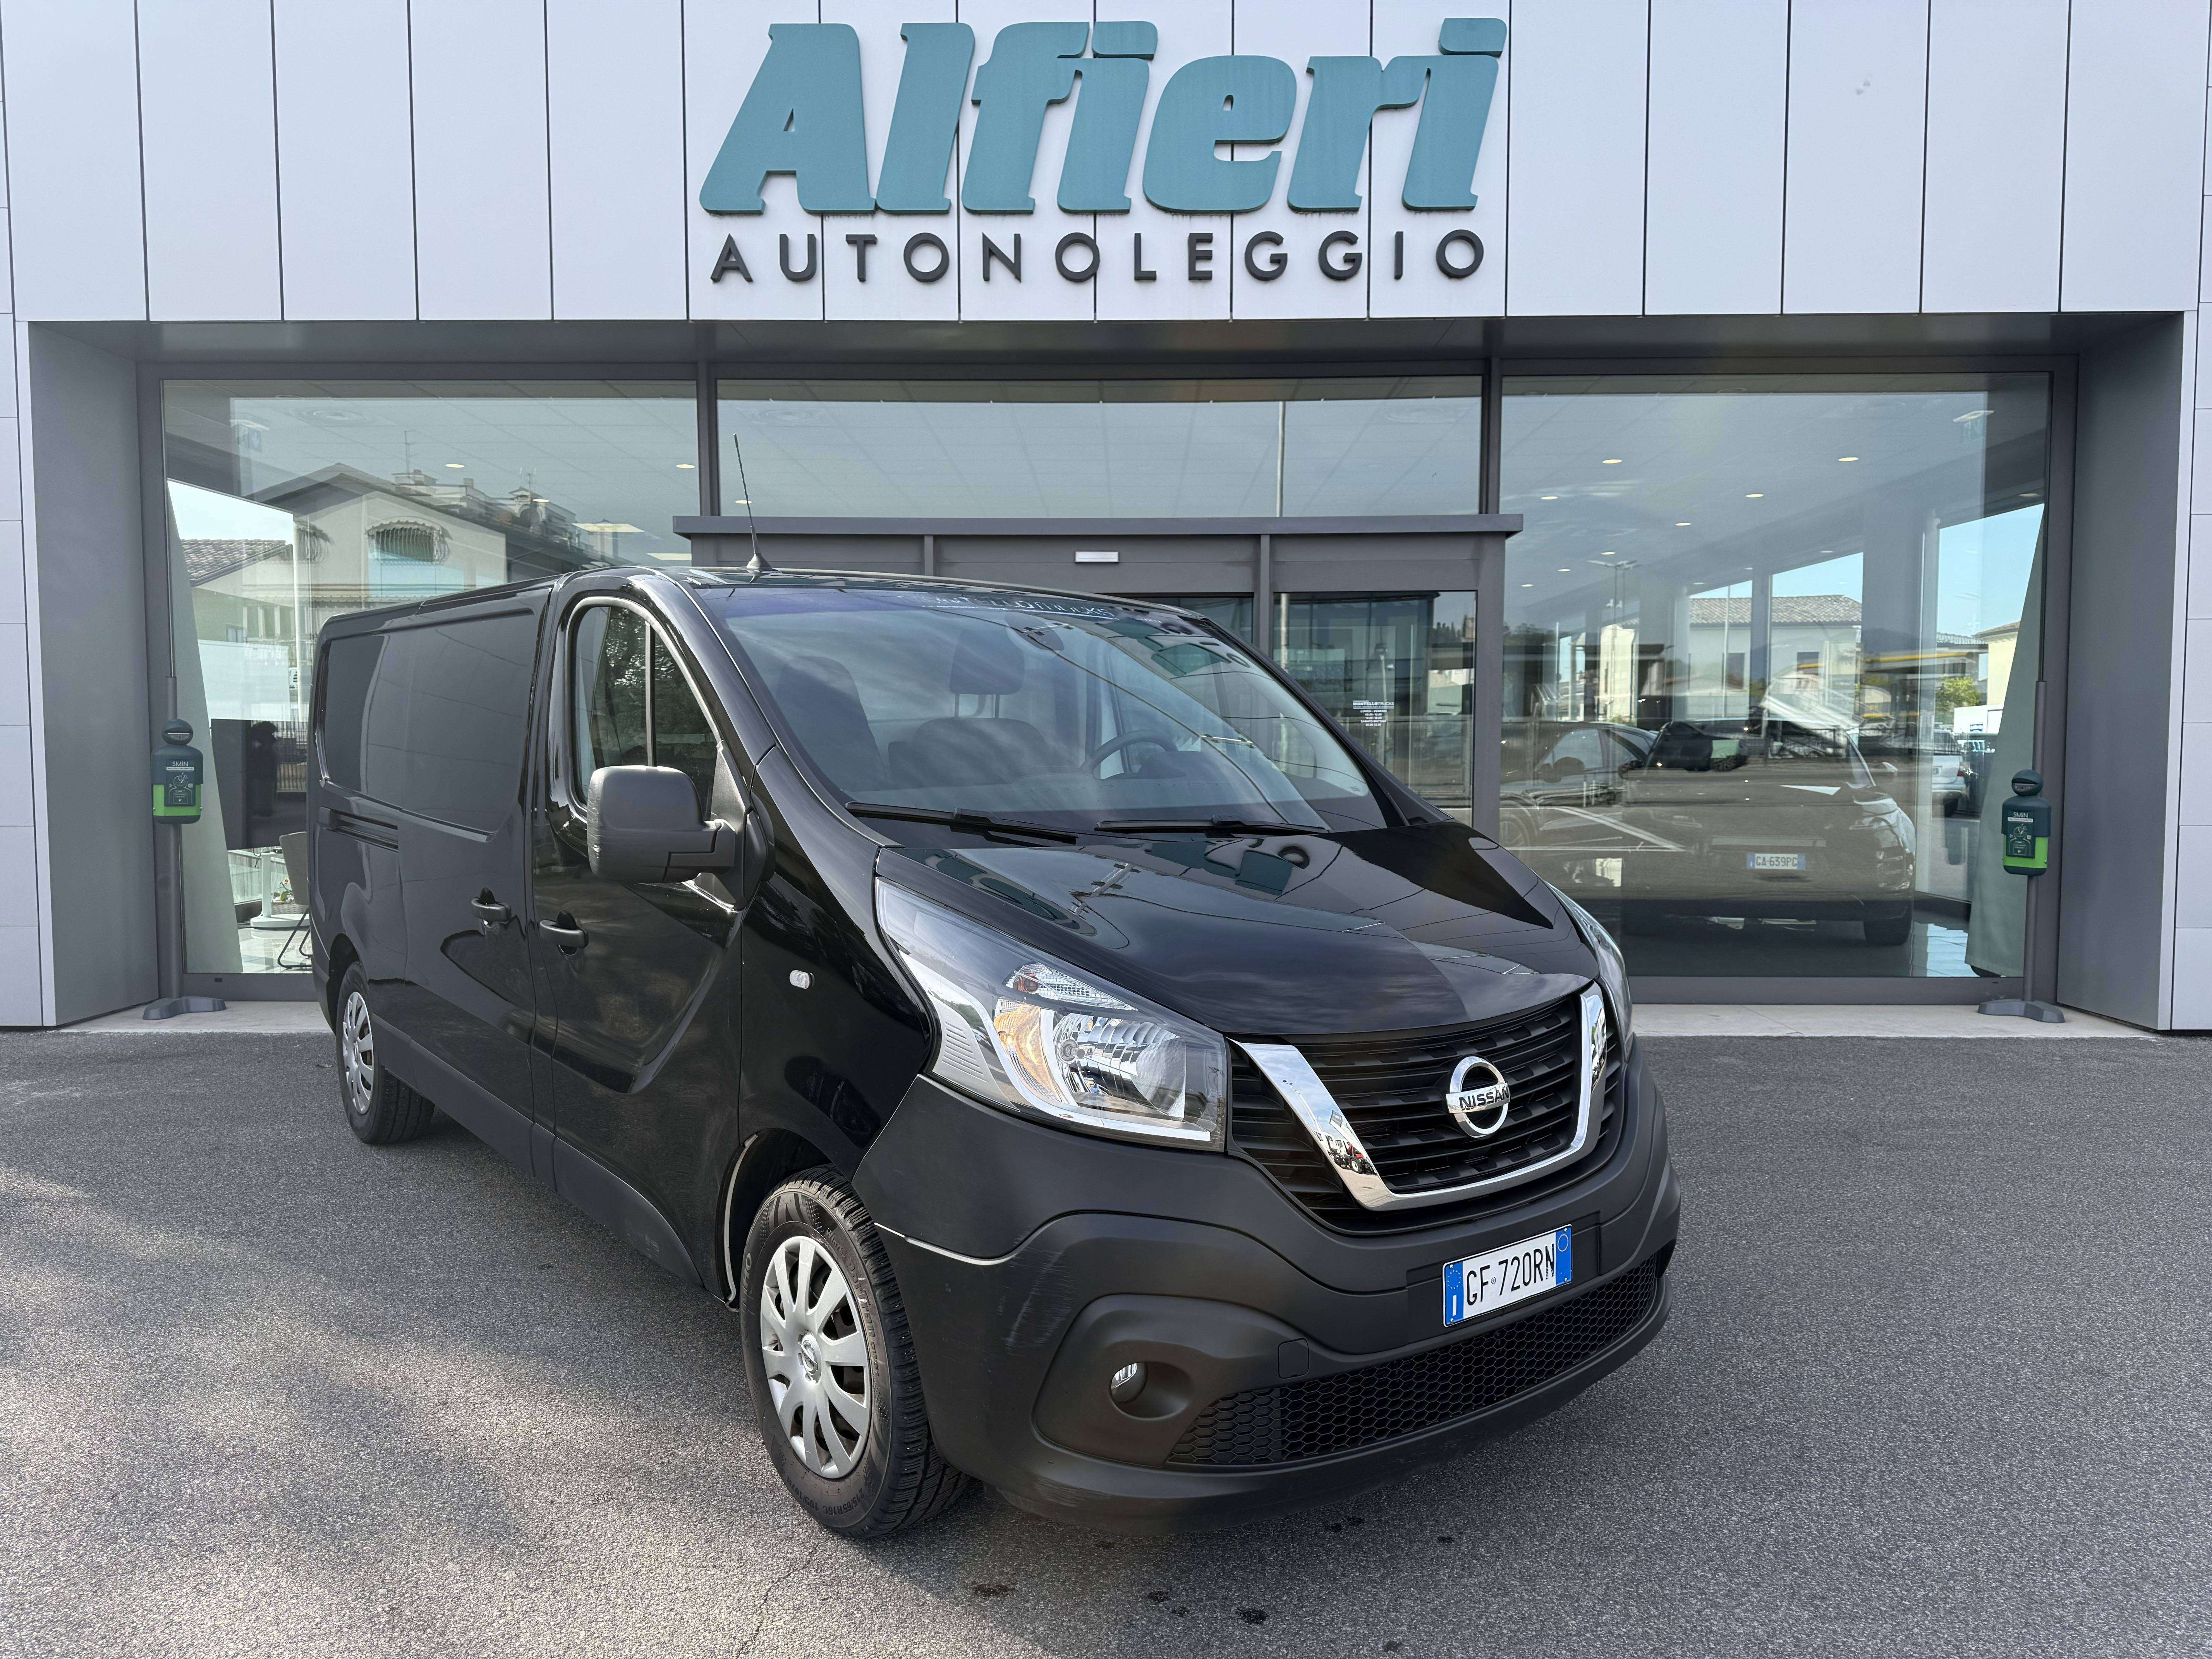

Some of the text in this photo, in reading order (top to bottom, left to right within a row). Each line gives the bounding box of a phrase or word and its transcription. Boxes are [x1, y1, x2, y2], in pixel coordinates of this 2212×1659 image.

[700, 18, 1507, 214] Alfieri
[711, 229, 1484, 282] AUTONOLEGGIO
[1459, 1087, 1509, 1109] NISSAN
[822, 1487, 865, 1516] 215/65R16C
